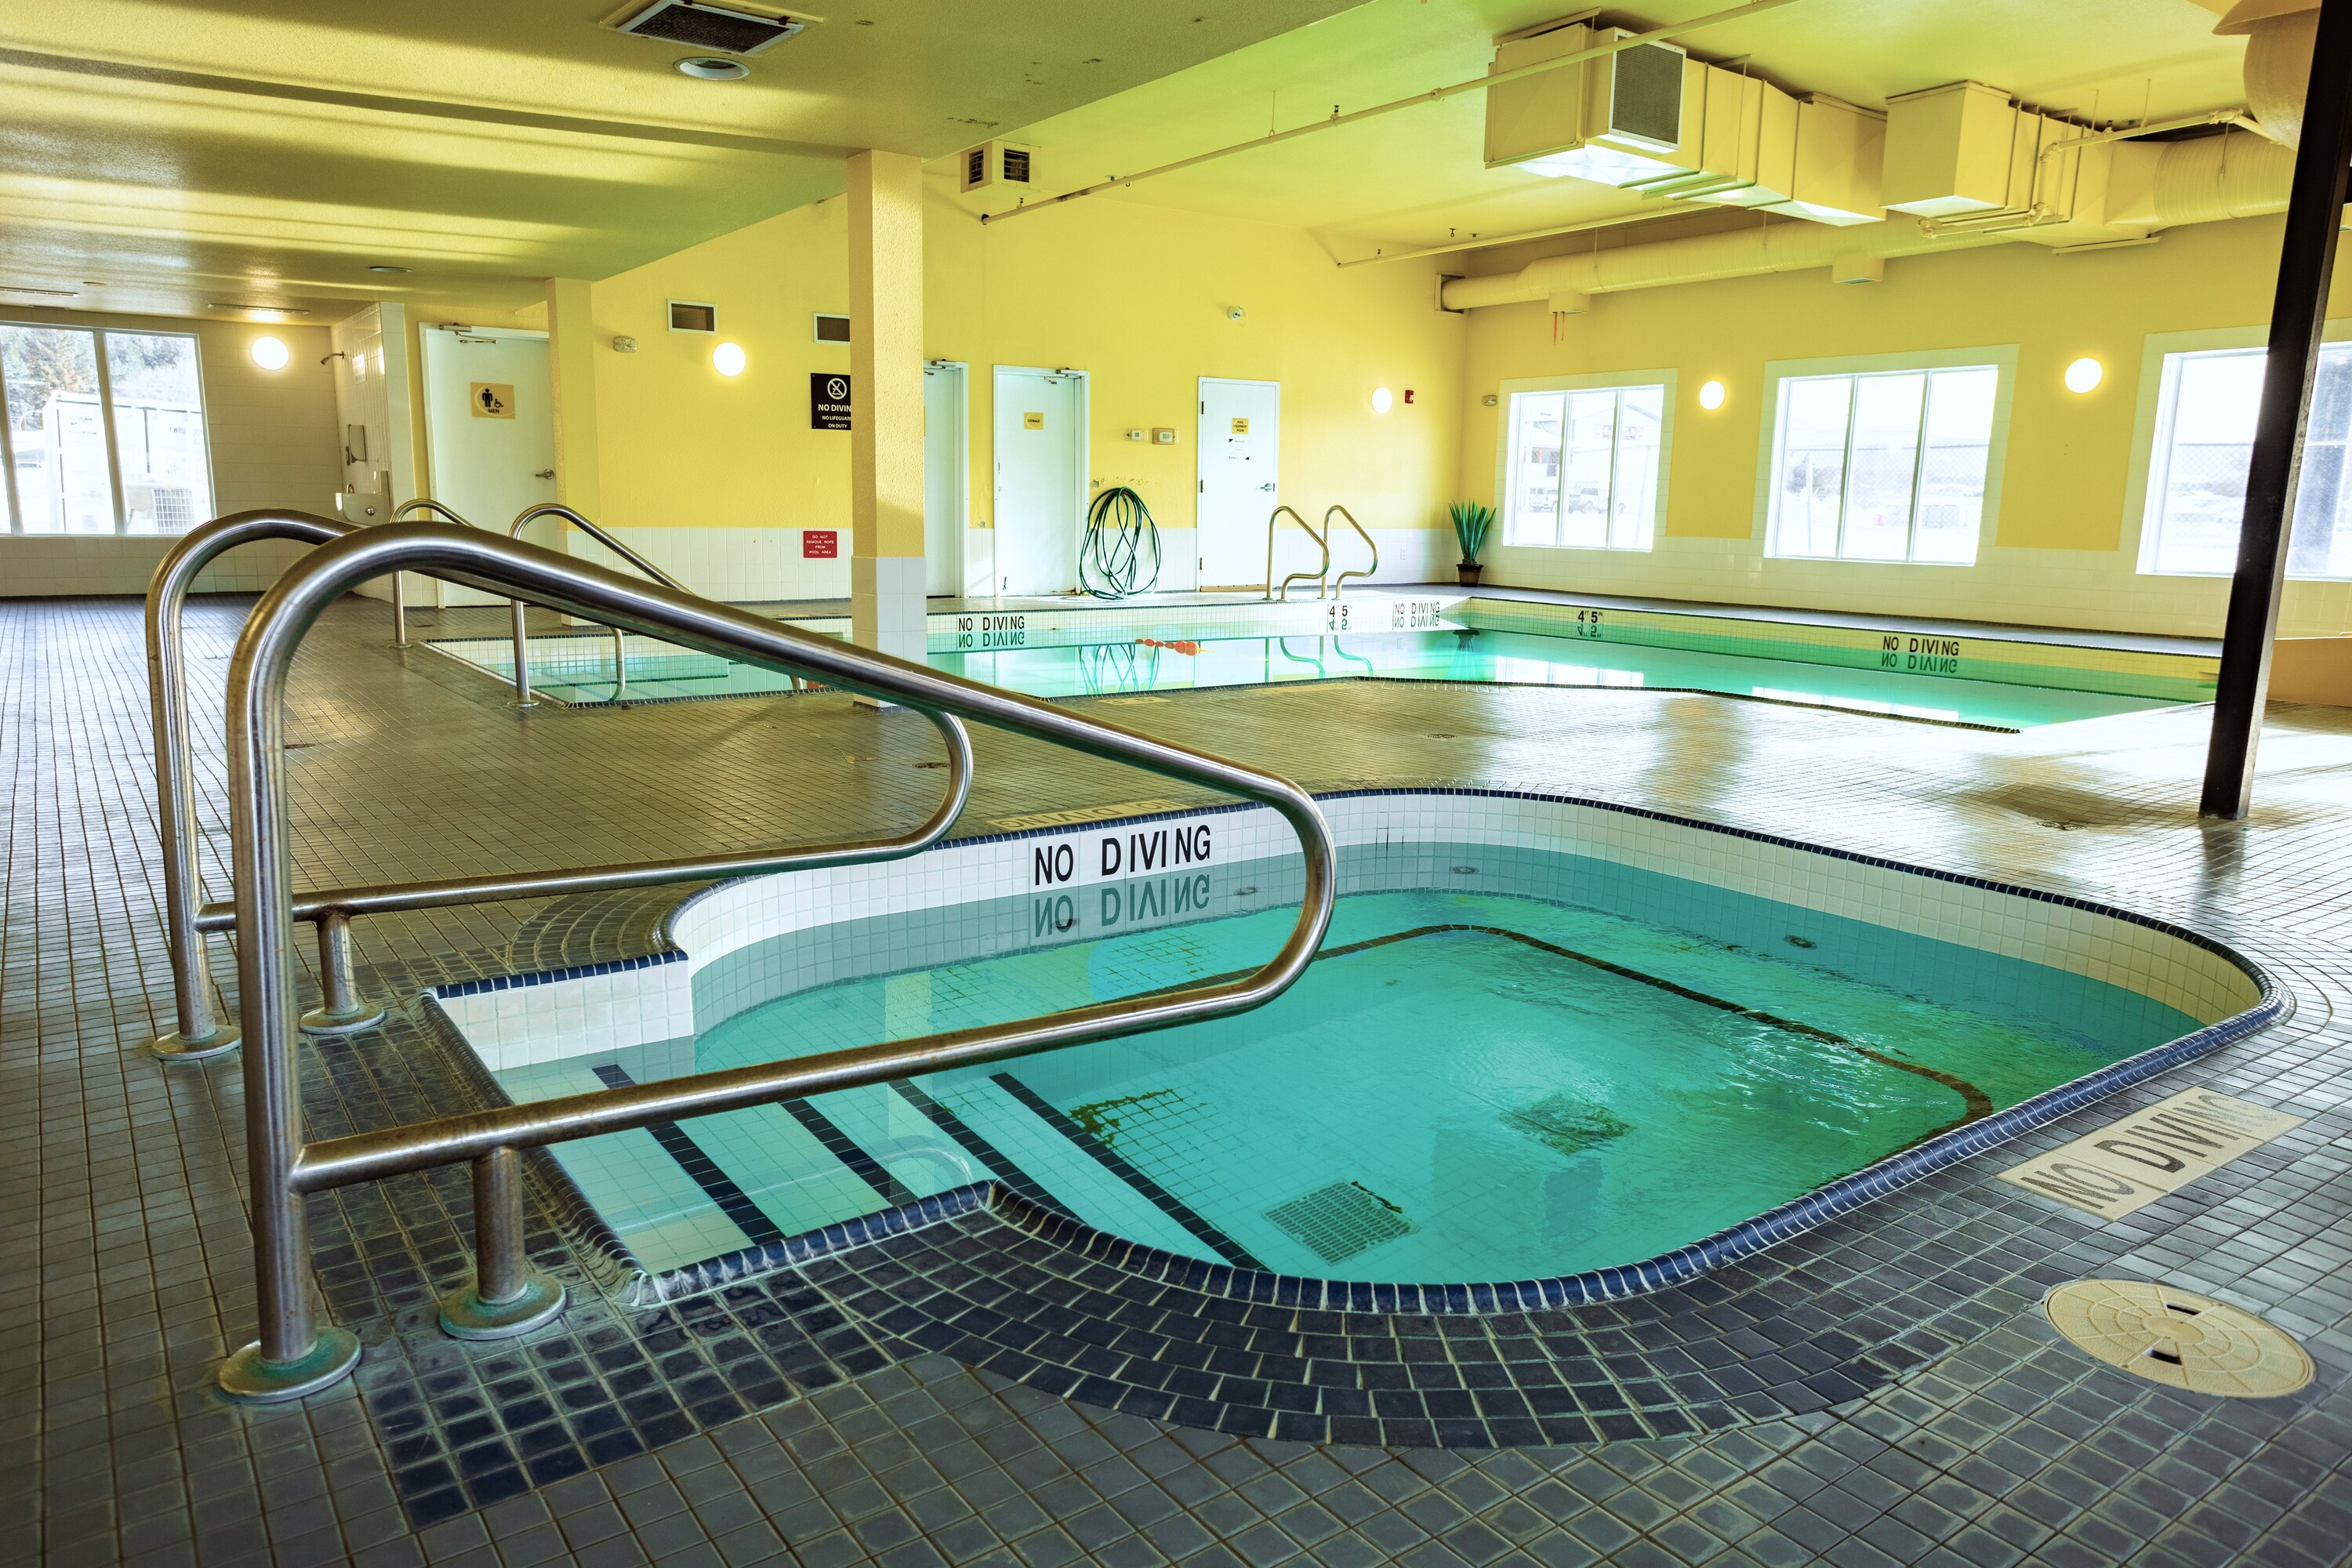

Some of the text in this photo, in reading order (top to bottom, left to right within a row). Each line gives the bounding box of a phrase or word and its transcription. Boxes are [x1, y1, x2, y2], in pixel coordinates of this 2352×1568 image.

[1395, 602, 1440, 615] NO DIVING
[958, 615, 1025, 632] NO DIVING
[1882, 636, 1959, 656] NO DIVING
[996, 800, 1184, 828] NO DIVING
[1035, 825, 1210, 886] NO DIVING
[2020, 1094, 2278, 1210] NO DIVING
